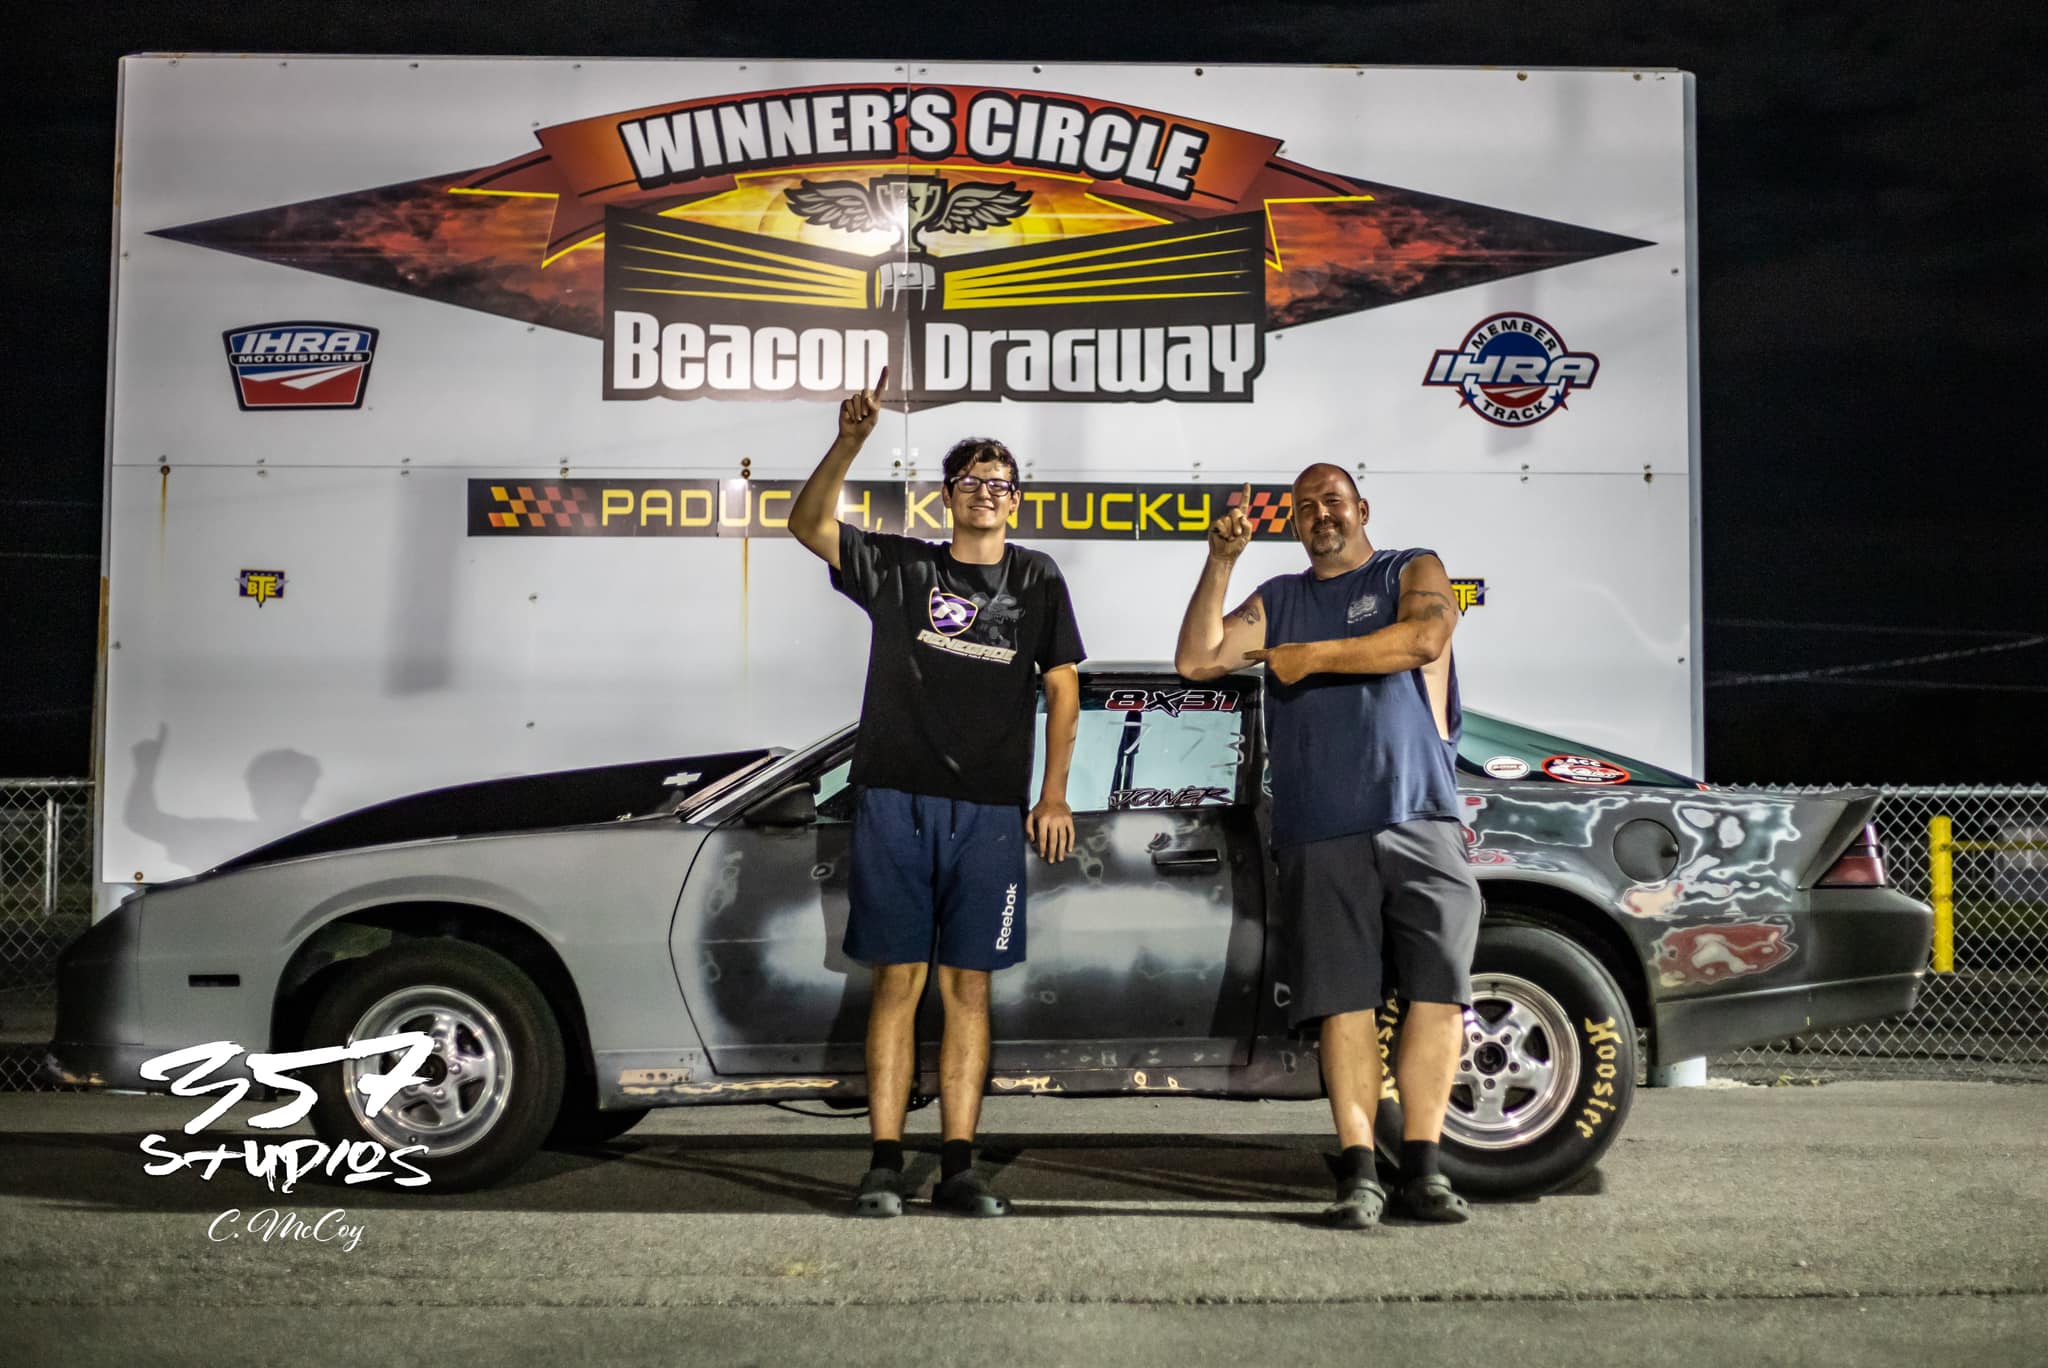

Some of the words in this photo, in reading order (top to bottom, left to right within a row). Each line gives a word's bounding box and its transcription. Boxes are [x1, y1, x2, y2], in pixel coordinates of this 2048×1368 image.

[620, 93, 953, 181] WINNER'S
[969, 97, 1203, 190] CIRCLE
[241, 331, 361, 354] IHRA
[1470, 319, 1558, 351] MEMBER
[238, 352, 363, 364] MOTORSPORTS
[613, 311, 889, 391] Beacon
[1429, 354, 1595, 384] IHRA
[1482, 399, 1548, 421] TRACK
[602, 488, 882, 531] PADUCH,
[907, 491, 1211, 531] KTUCKY
[247, 575, 277, 604] BTE
[1450, 583, 1478, 613] TE
[995, 883, 1018, 951] Reebok
[1576, 1015, 1623, 1138] Hoosier
